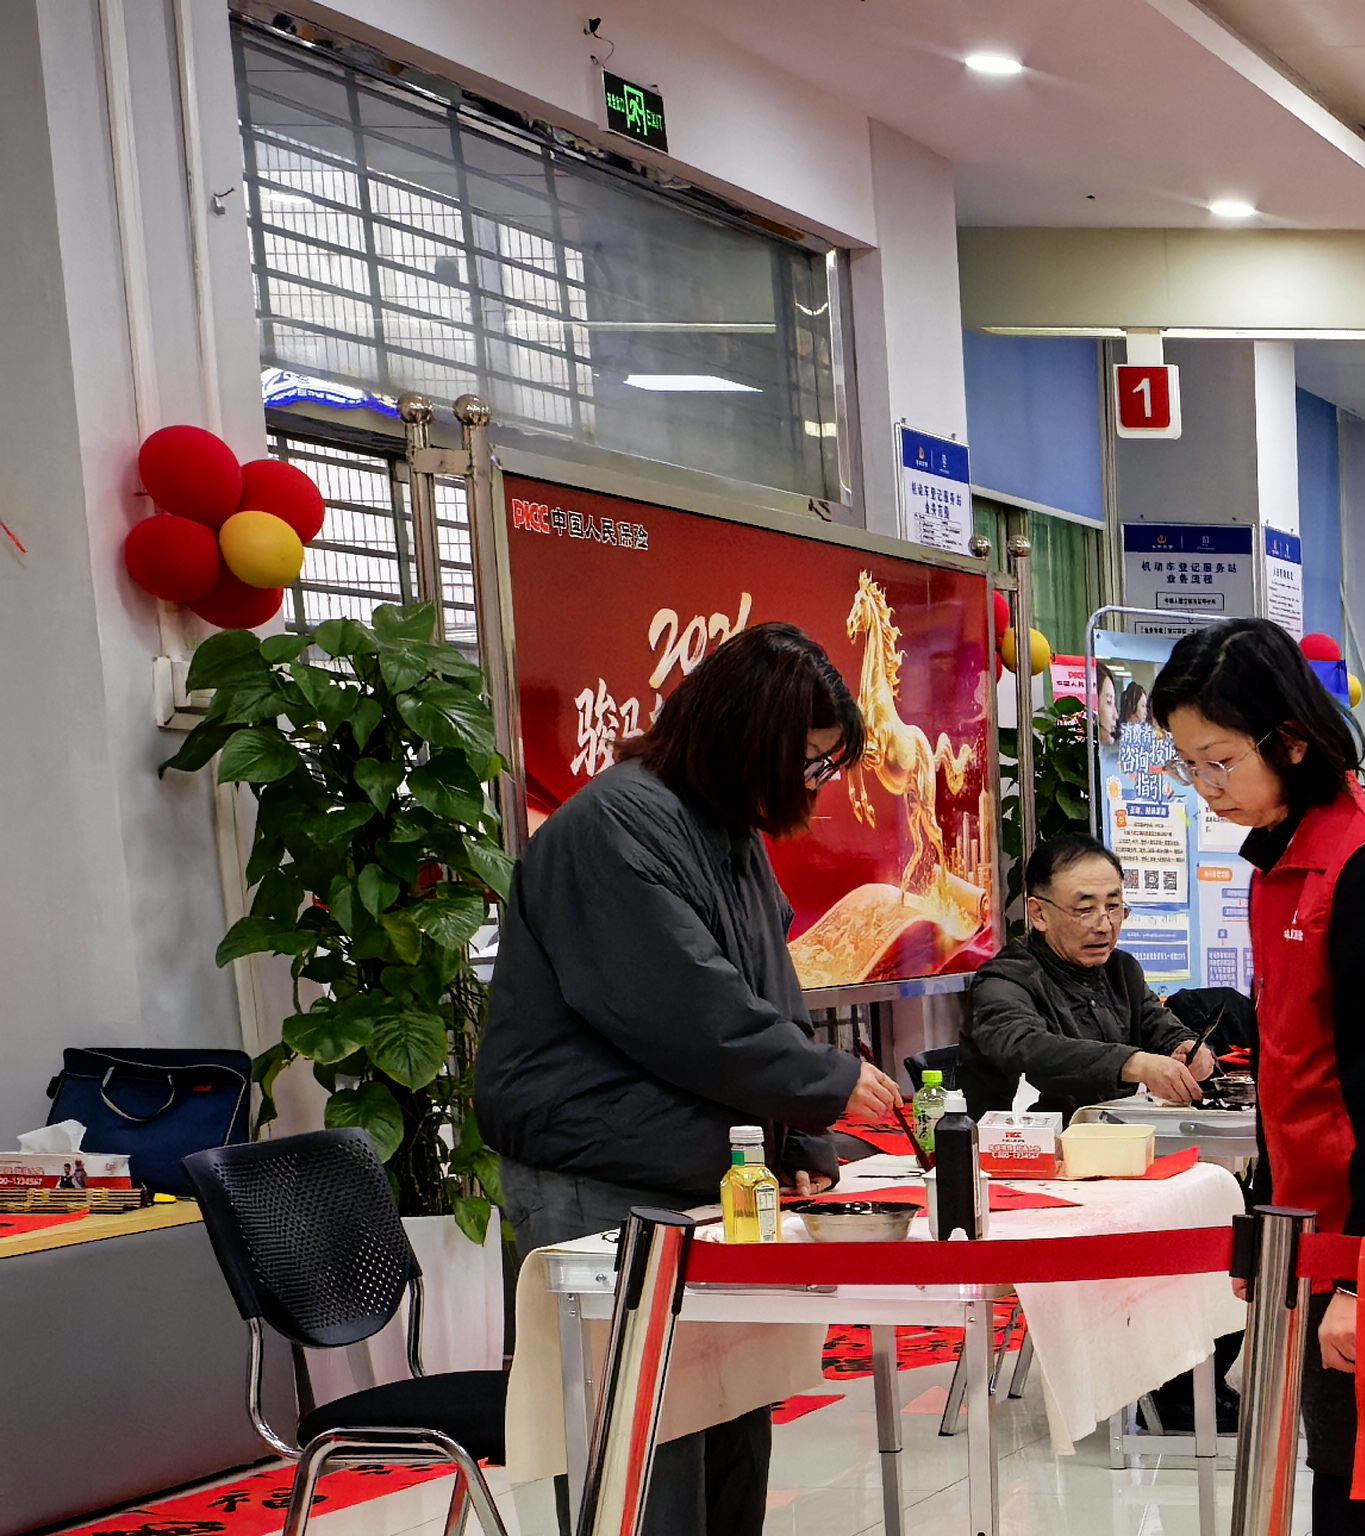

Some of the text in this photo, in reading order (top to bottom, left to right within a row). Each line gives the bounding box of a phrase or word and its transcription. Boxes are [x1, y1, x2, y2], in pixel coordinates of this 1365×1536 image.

[1131, 377, 1153, 419] 1
[511, 498, 649, 551] PICC 中国人民保险
